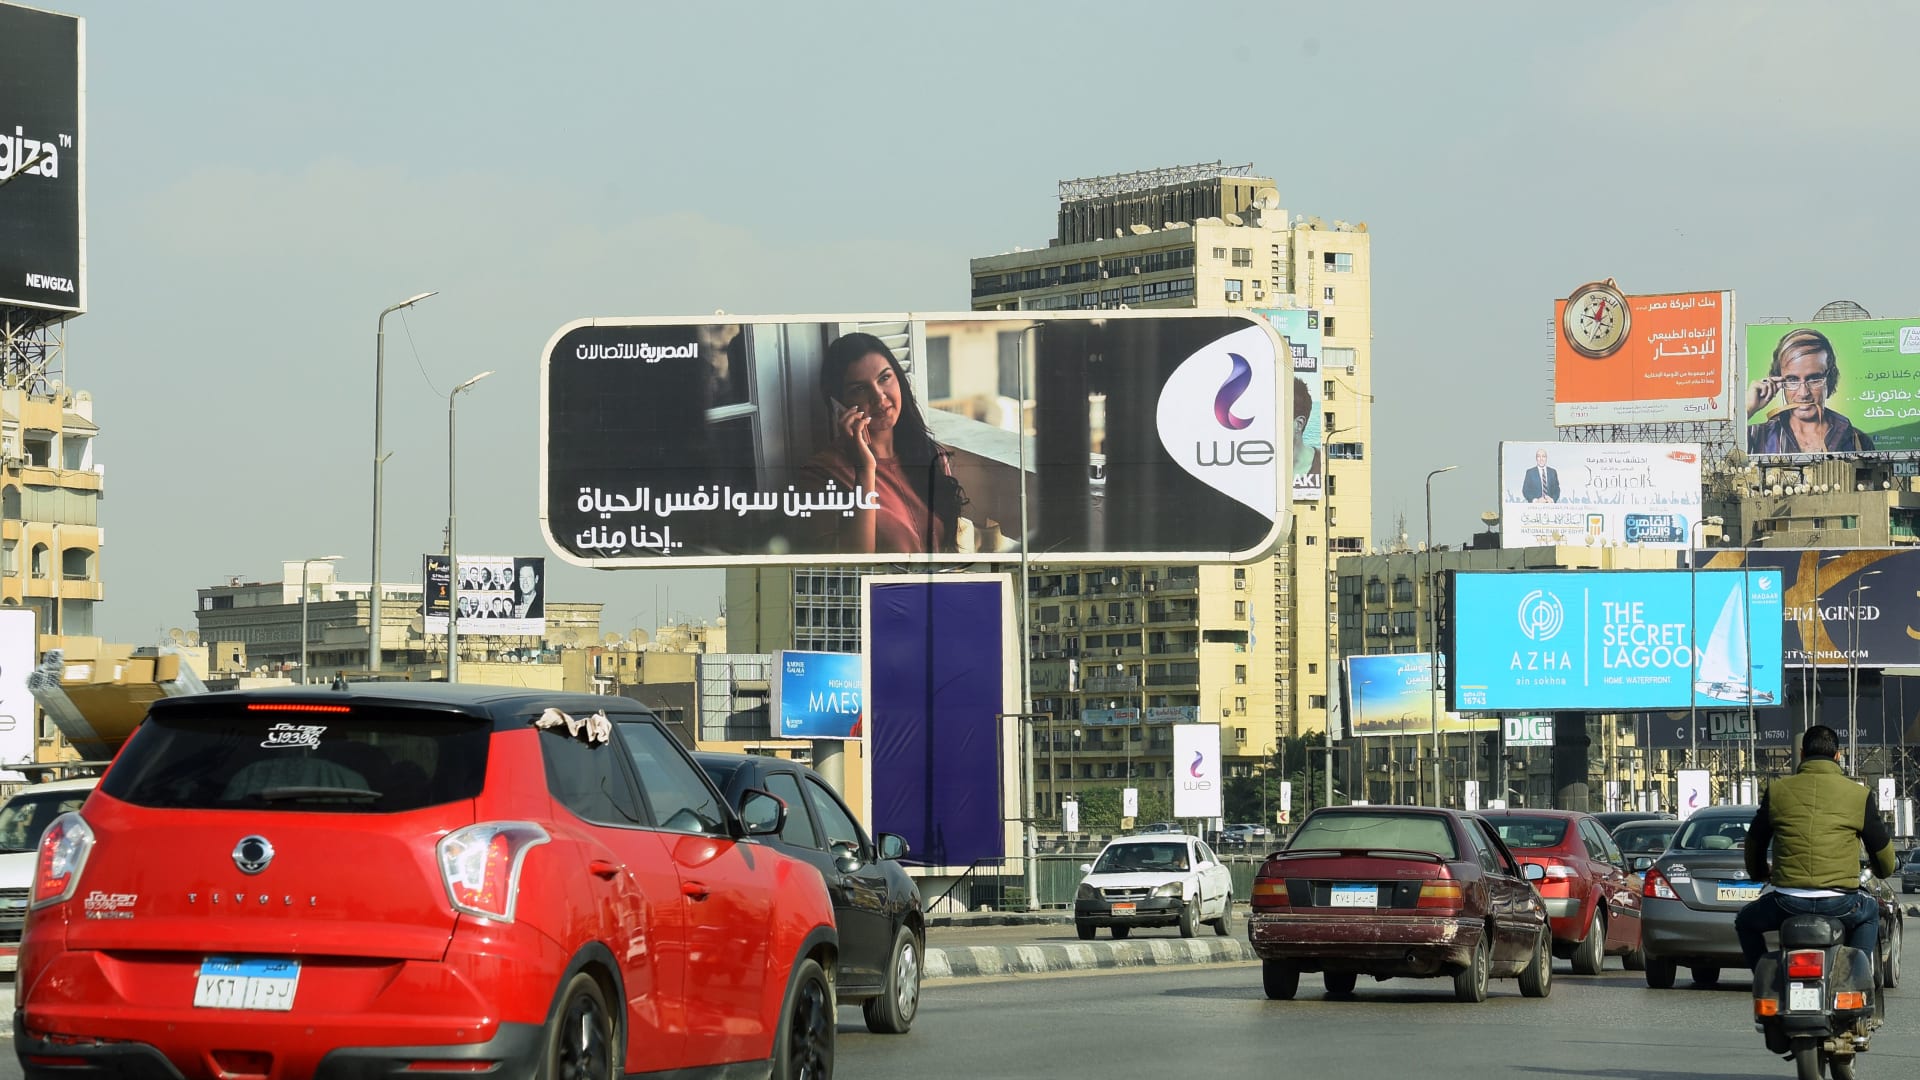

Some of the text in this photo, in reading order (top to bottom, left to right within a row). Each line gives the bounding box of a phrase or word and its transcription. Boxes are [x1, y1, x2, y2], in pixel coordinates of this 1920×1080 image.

[0, 126, 58, 179] giza
[26, 273, 74, 293] NEWGIZA
[1648, 302, 1668, 311] مصر
[1670, 298, 1695, 310] البركة
[1698, 297, 1715, 308] بنك
[1648, 329, 1687, 344] الطبيعي
[640, 343, 698, 363] المصرية
[1892, 369, 1911, 378] كلنا
[1684, 403, 1709, 413] البركة
[1863, 406, 1895, 417] حقك
[1197, 440, 1275, 467] we
[1293, 473, 1321, 487] AKI
[577, 479, 881, 519] عايشين سوا نفس الحياة
[1626, 515, 1671, 527] القاهرة
[1626, 526, 1671, 539] والناس
[1602, 602, 1644, 624] THE
[1783, 605, 1880, 621] EIMAGINED
[1603, 623, 1686, 646] SECRET
[1510, 650, 1572, 670] AZHA
[1516, 676, 1567, 686] ain sokhna
[809, 690, 859, 714] MAES
[277, 732, 320, 744] 19396
[1183, 781, 1212, 791] we
[187, 893, 317, 907] TIVOLI
[206, 979, 235, 996] ٧٢٦
